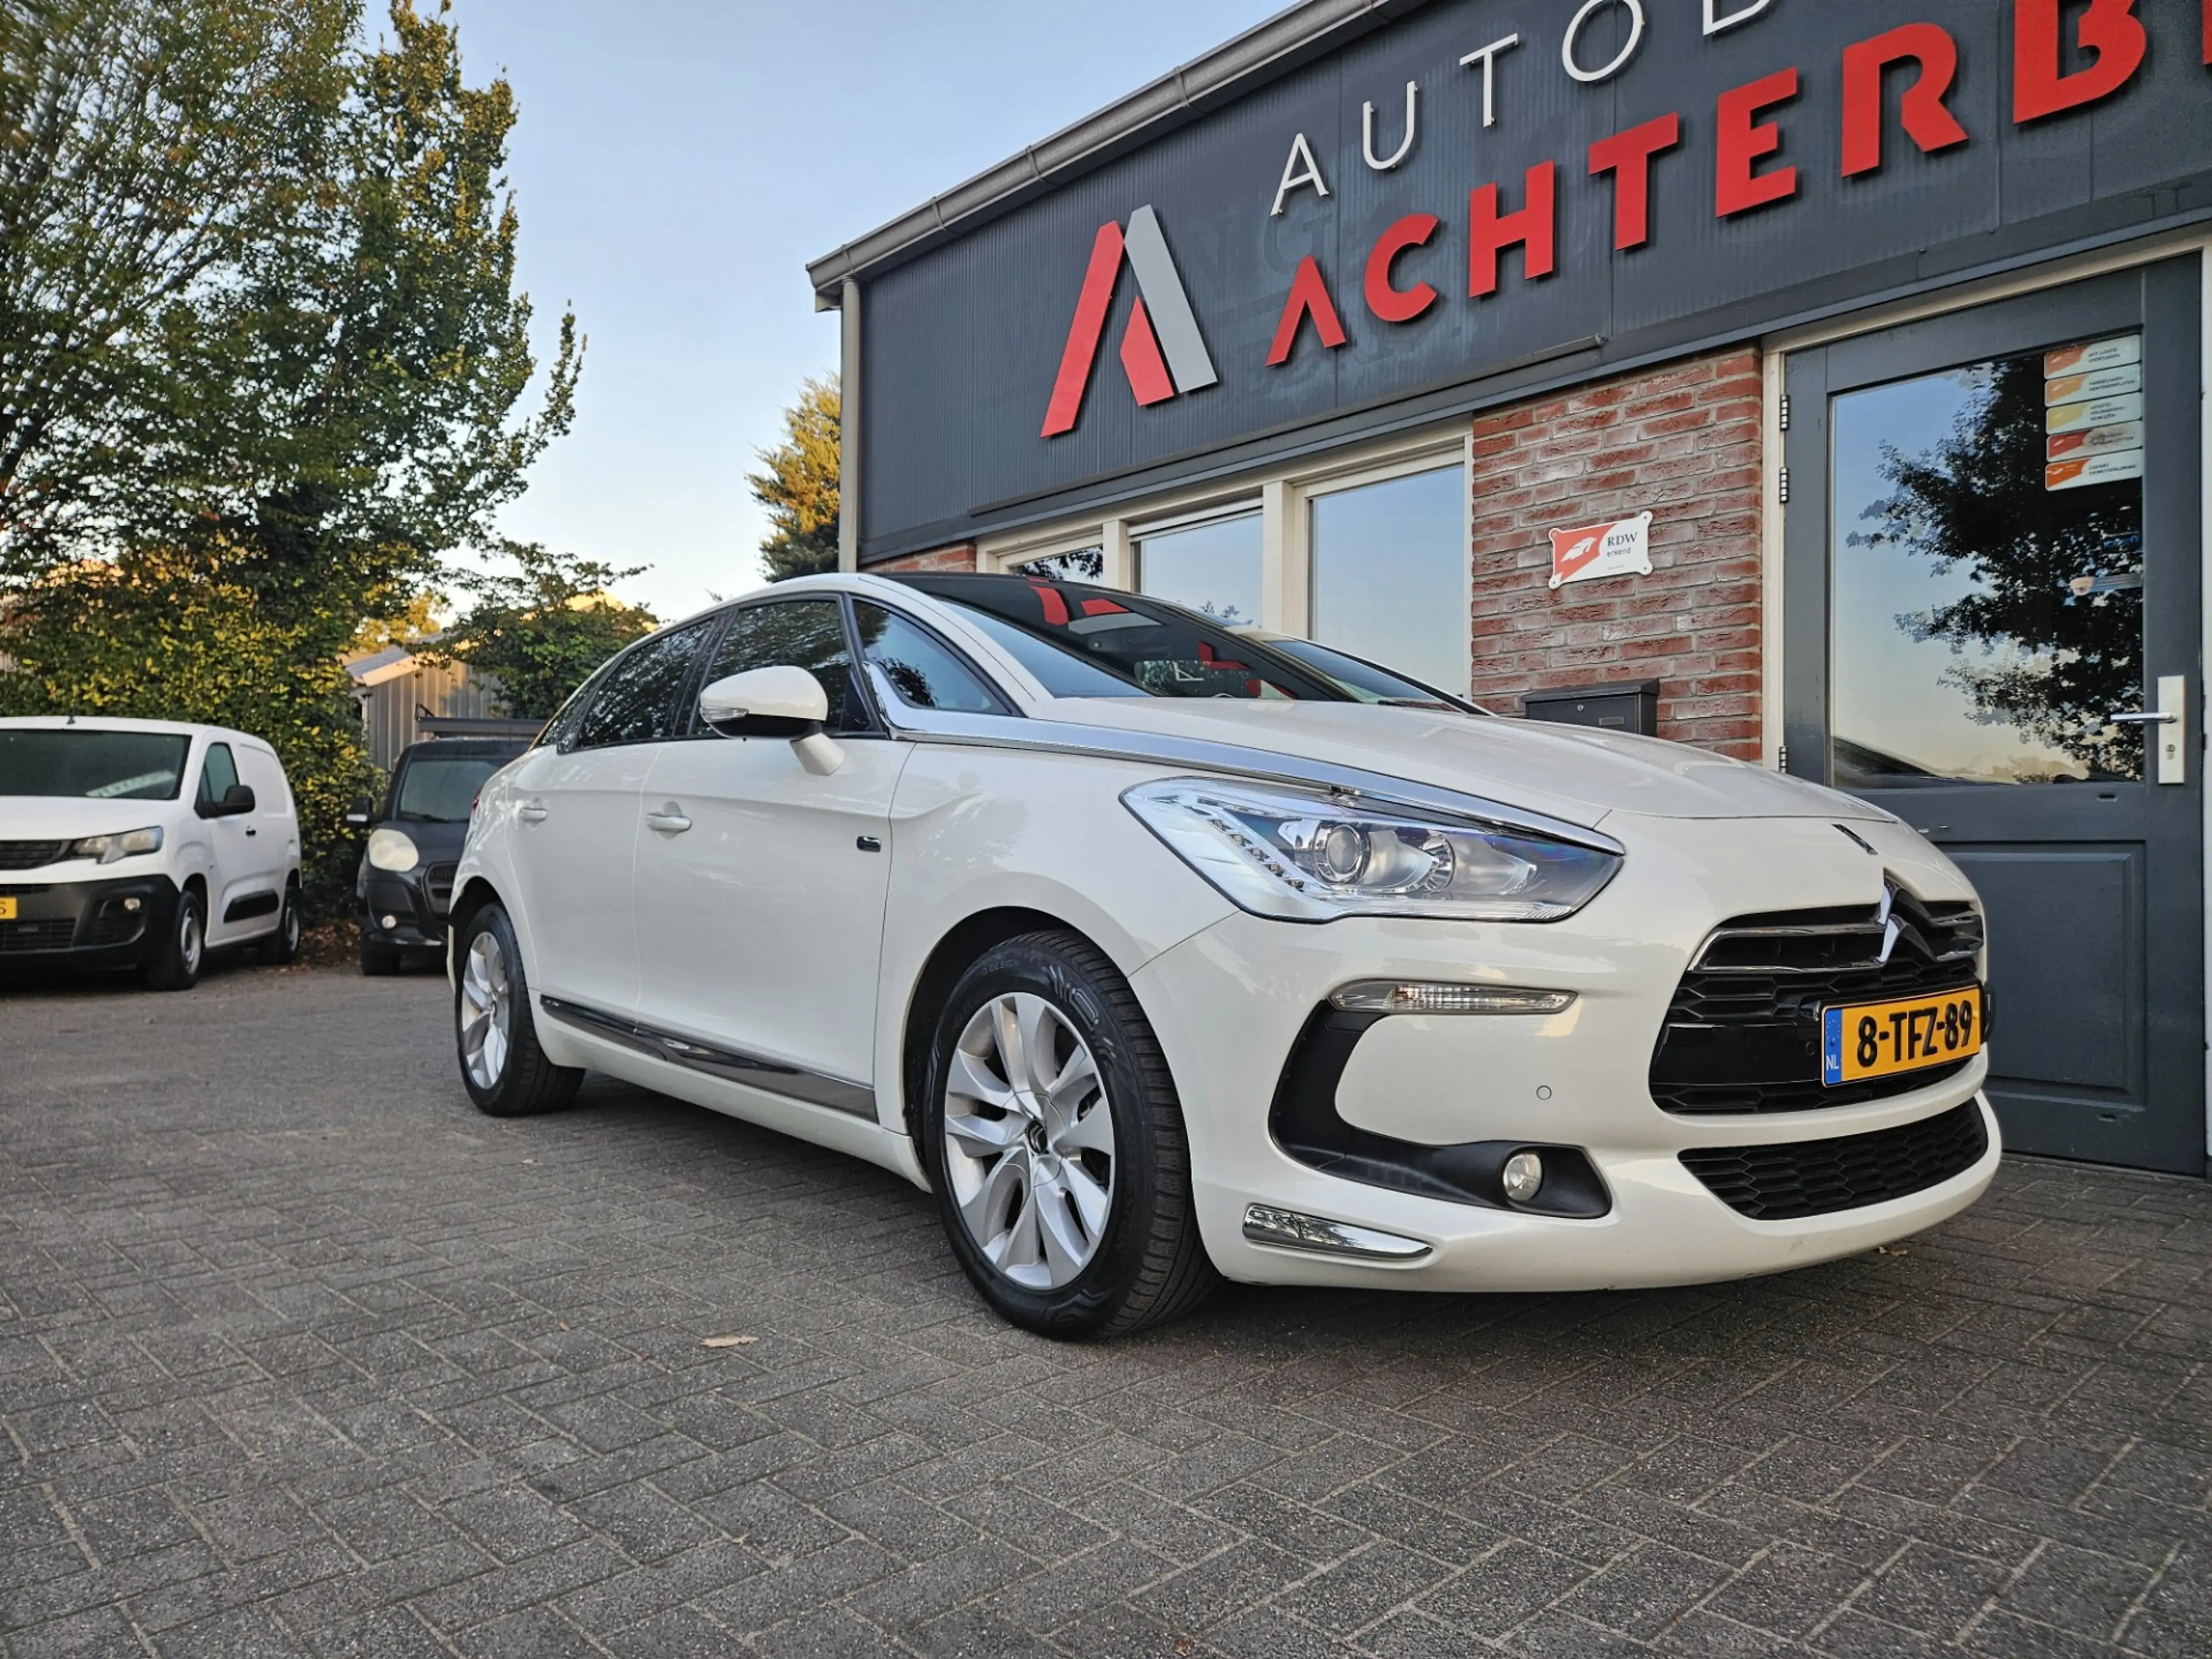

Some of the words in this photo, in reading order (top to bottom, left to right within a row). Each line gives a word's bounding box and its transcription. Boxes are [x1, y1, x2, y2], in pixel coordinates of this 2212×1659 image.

[1265, 0, 2212, 367] ACHTERB
[1607, 532, 1638, 547] RDW
[1607, 547, 1631, 557] erkend
[1857, 999, 1972, 1068] 8-TFZ-89
[1825, 1054, 1840, 1071] NL
